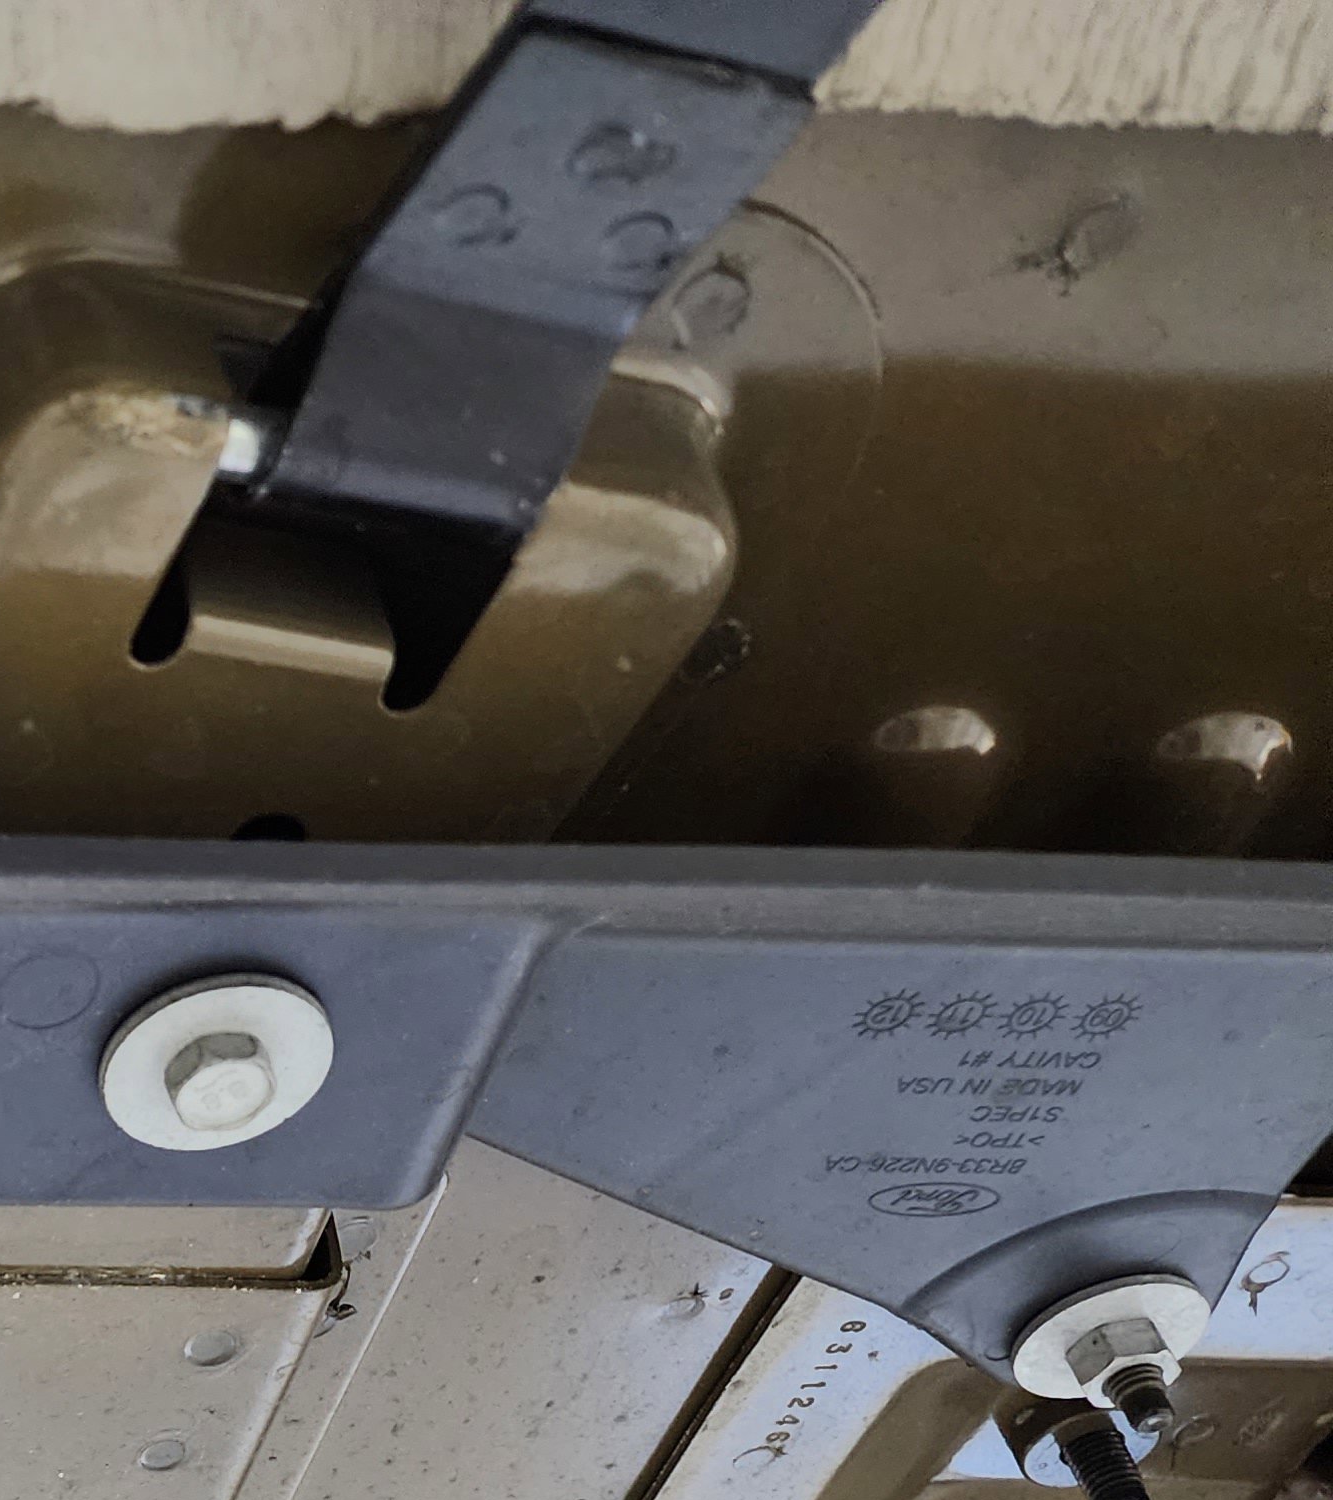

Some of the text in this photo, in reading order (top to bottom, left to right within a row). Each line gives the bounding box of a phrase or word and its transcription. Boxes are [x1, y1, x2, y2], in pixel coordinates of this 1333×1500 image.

[957, 1049, 1102, 1069] CAVITY #1
[896, 1075, 1085, 1096] MADE IN USA
